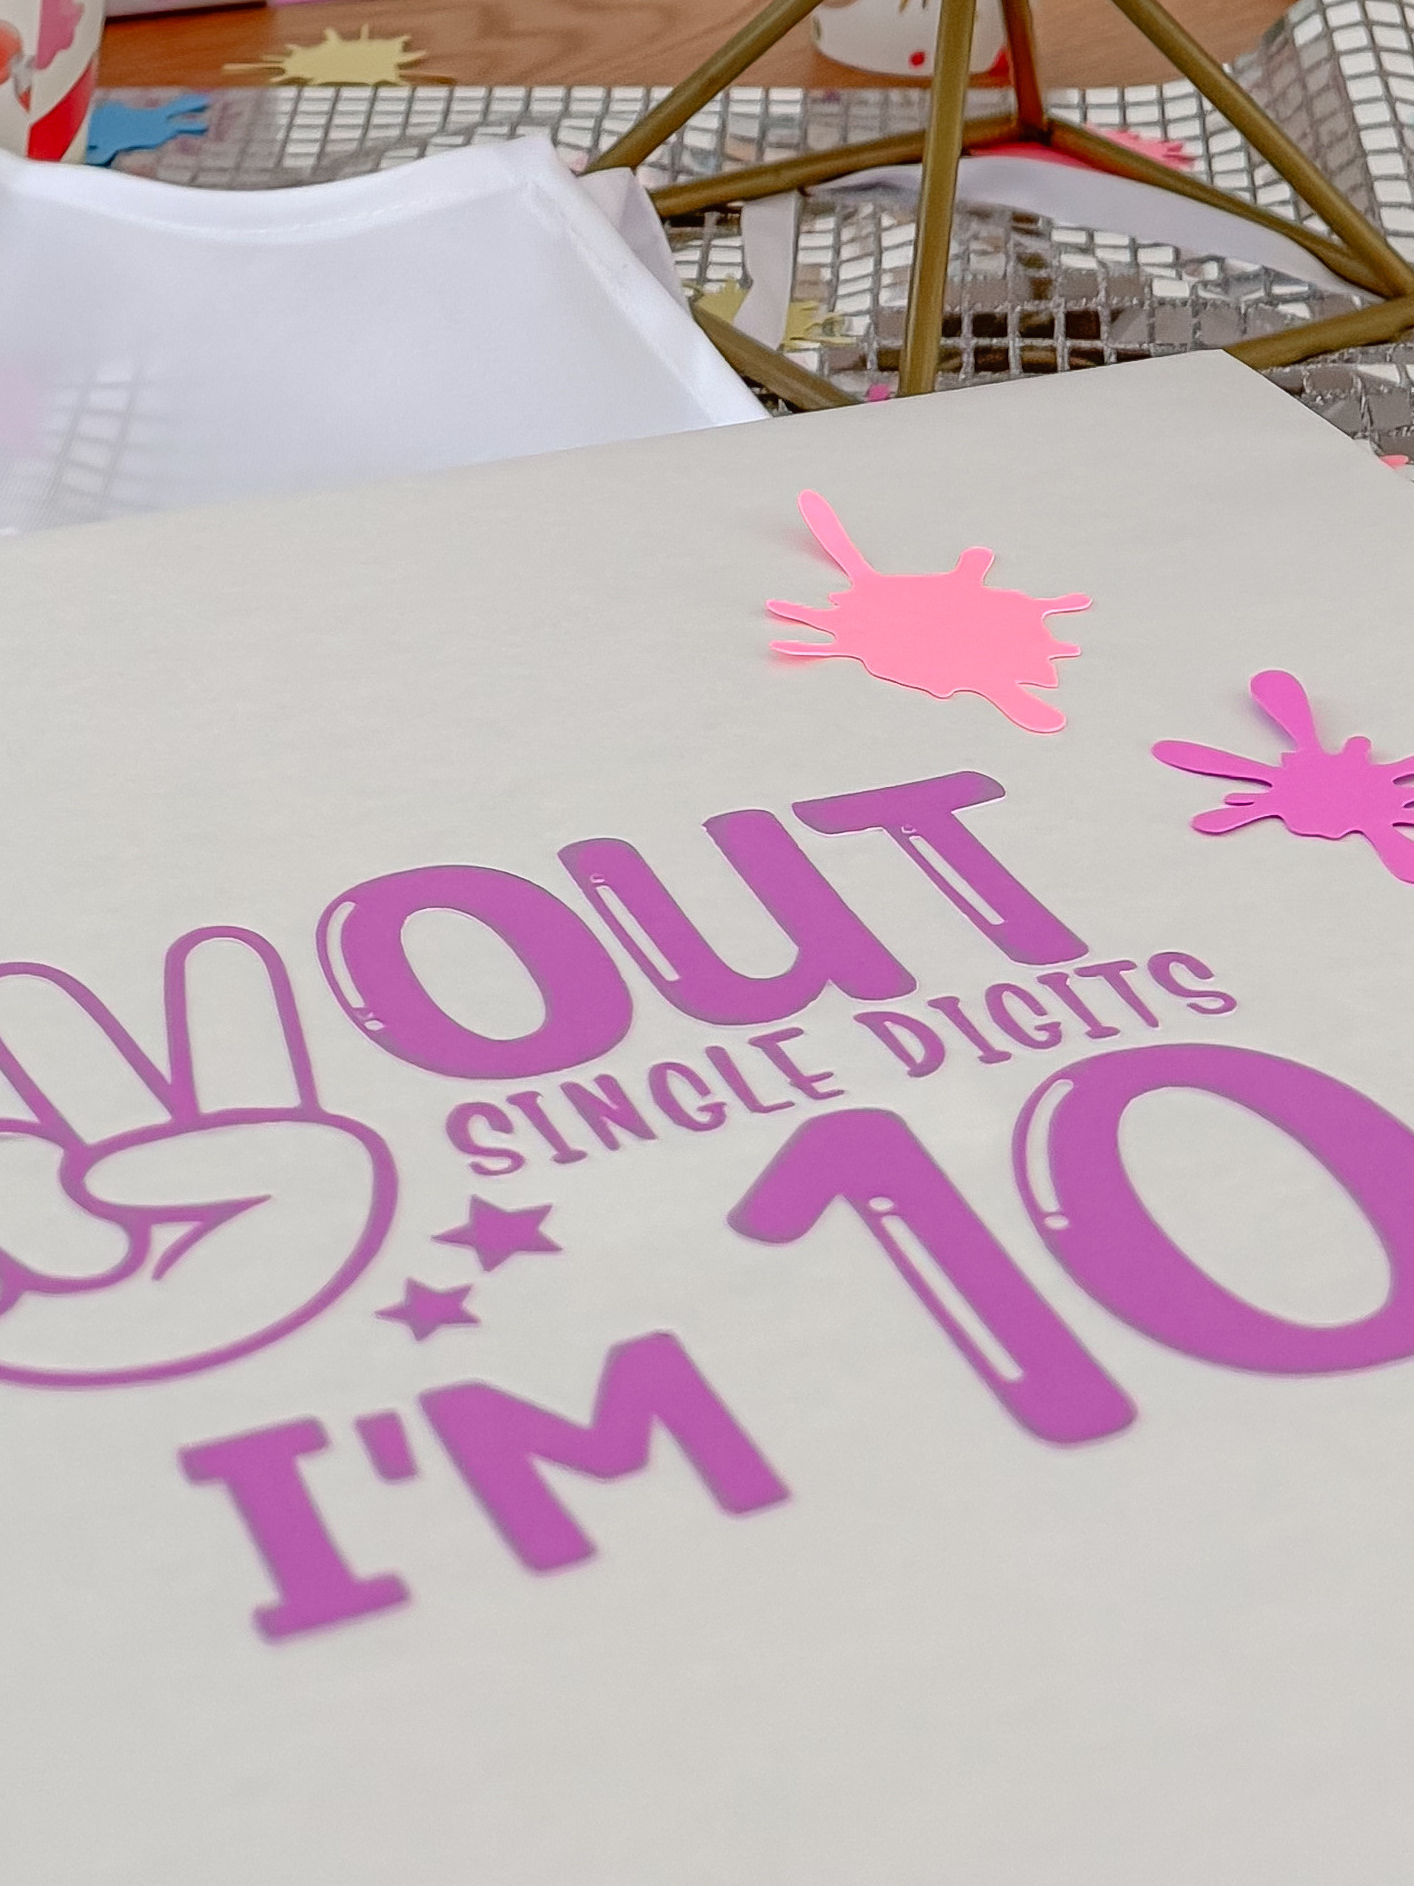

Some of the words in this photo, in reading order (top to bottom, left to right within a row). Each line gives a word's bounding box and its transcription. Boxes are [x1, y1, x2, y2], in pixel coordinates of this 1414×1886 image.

[314, 770, 1090, 1080] OUT
[443, 1026, 846, 1178] SINGLE
[853, 951, 1239, 1078] DIGITS
[177, 1329, 791, 1643] I'M
